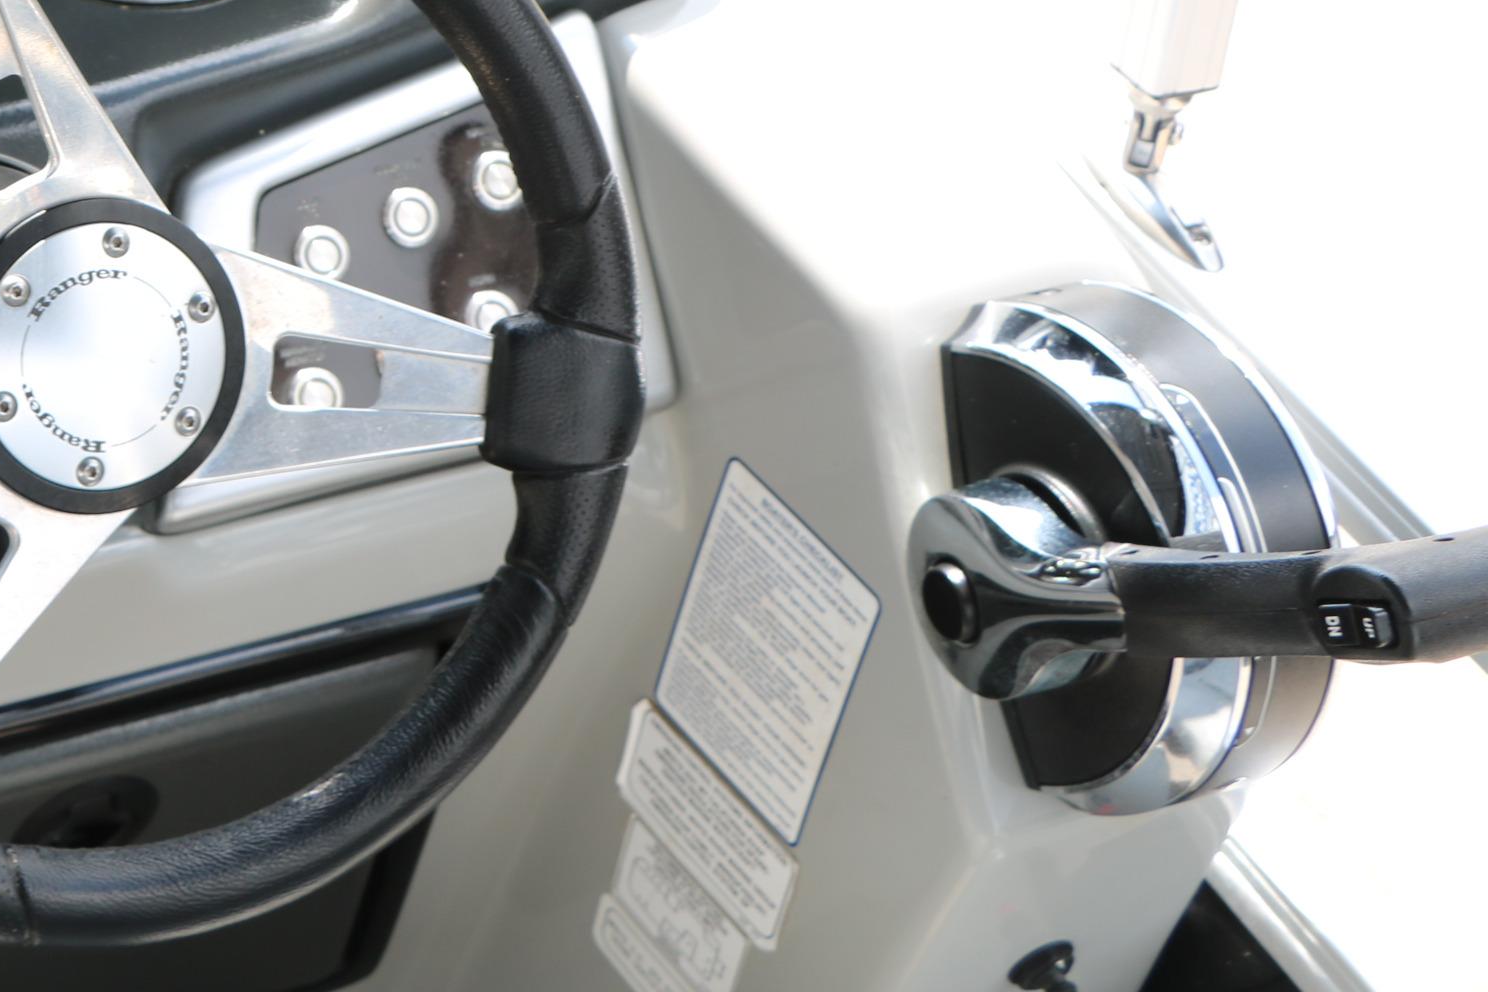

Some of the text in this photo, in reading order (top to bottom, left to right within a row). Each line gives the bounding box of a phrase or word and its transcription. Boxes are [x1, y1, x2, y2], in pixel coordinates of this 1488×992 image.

[27, 268, 128, 322] Ranger
[160, 309, 190, 422] Ranger
[22, 383, 107, 454] Ranger
[1324, 615, 1344, 638] DN
